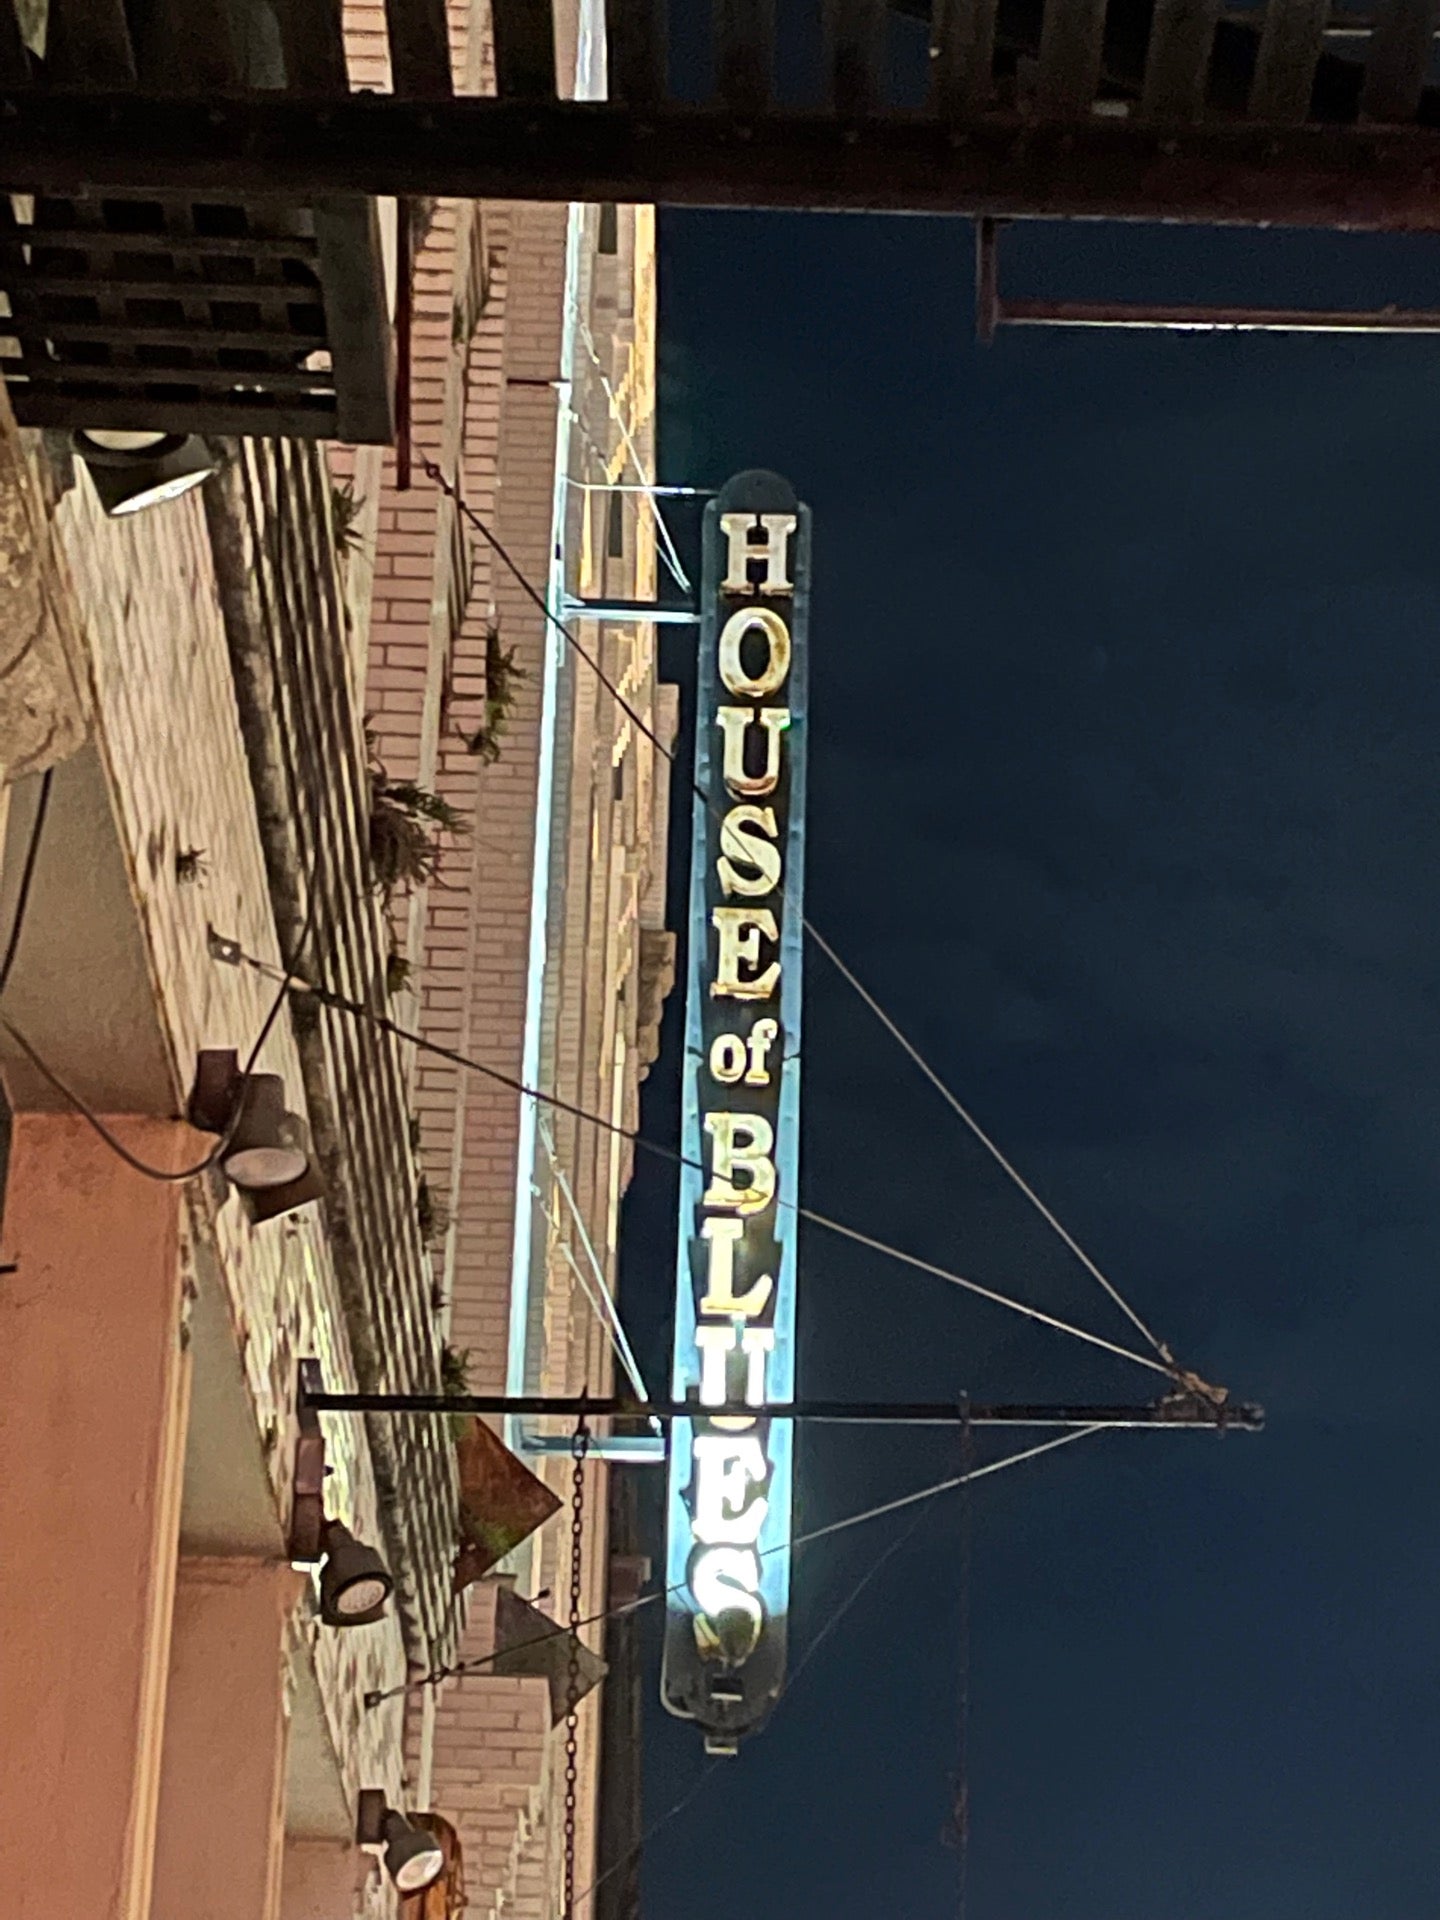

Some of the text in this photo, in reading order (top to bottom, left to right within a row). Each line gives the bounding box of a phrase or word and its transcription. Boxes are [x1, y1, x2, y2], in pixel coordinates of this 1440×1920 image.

[693, 513, 797, 1666] HOUSE of BLUES
